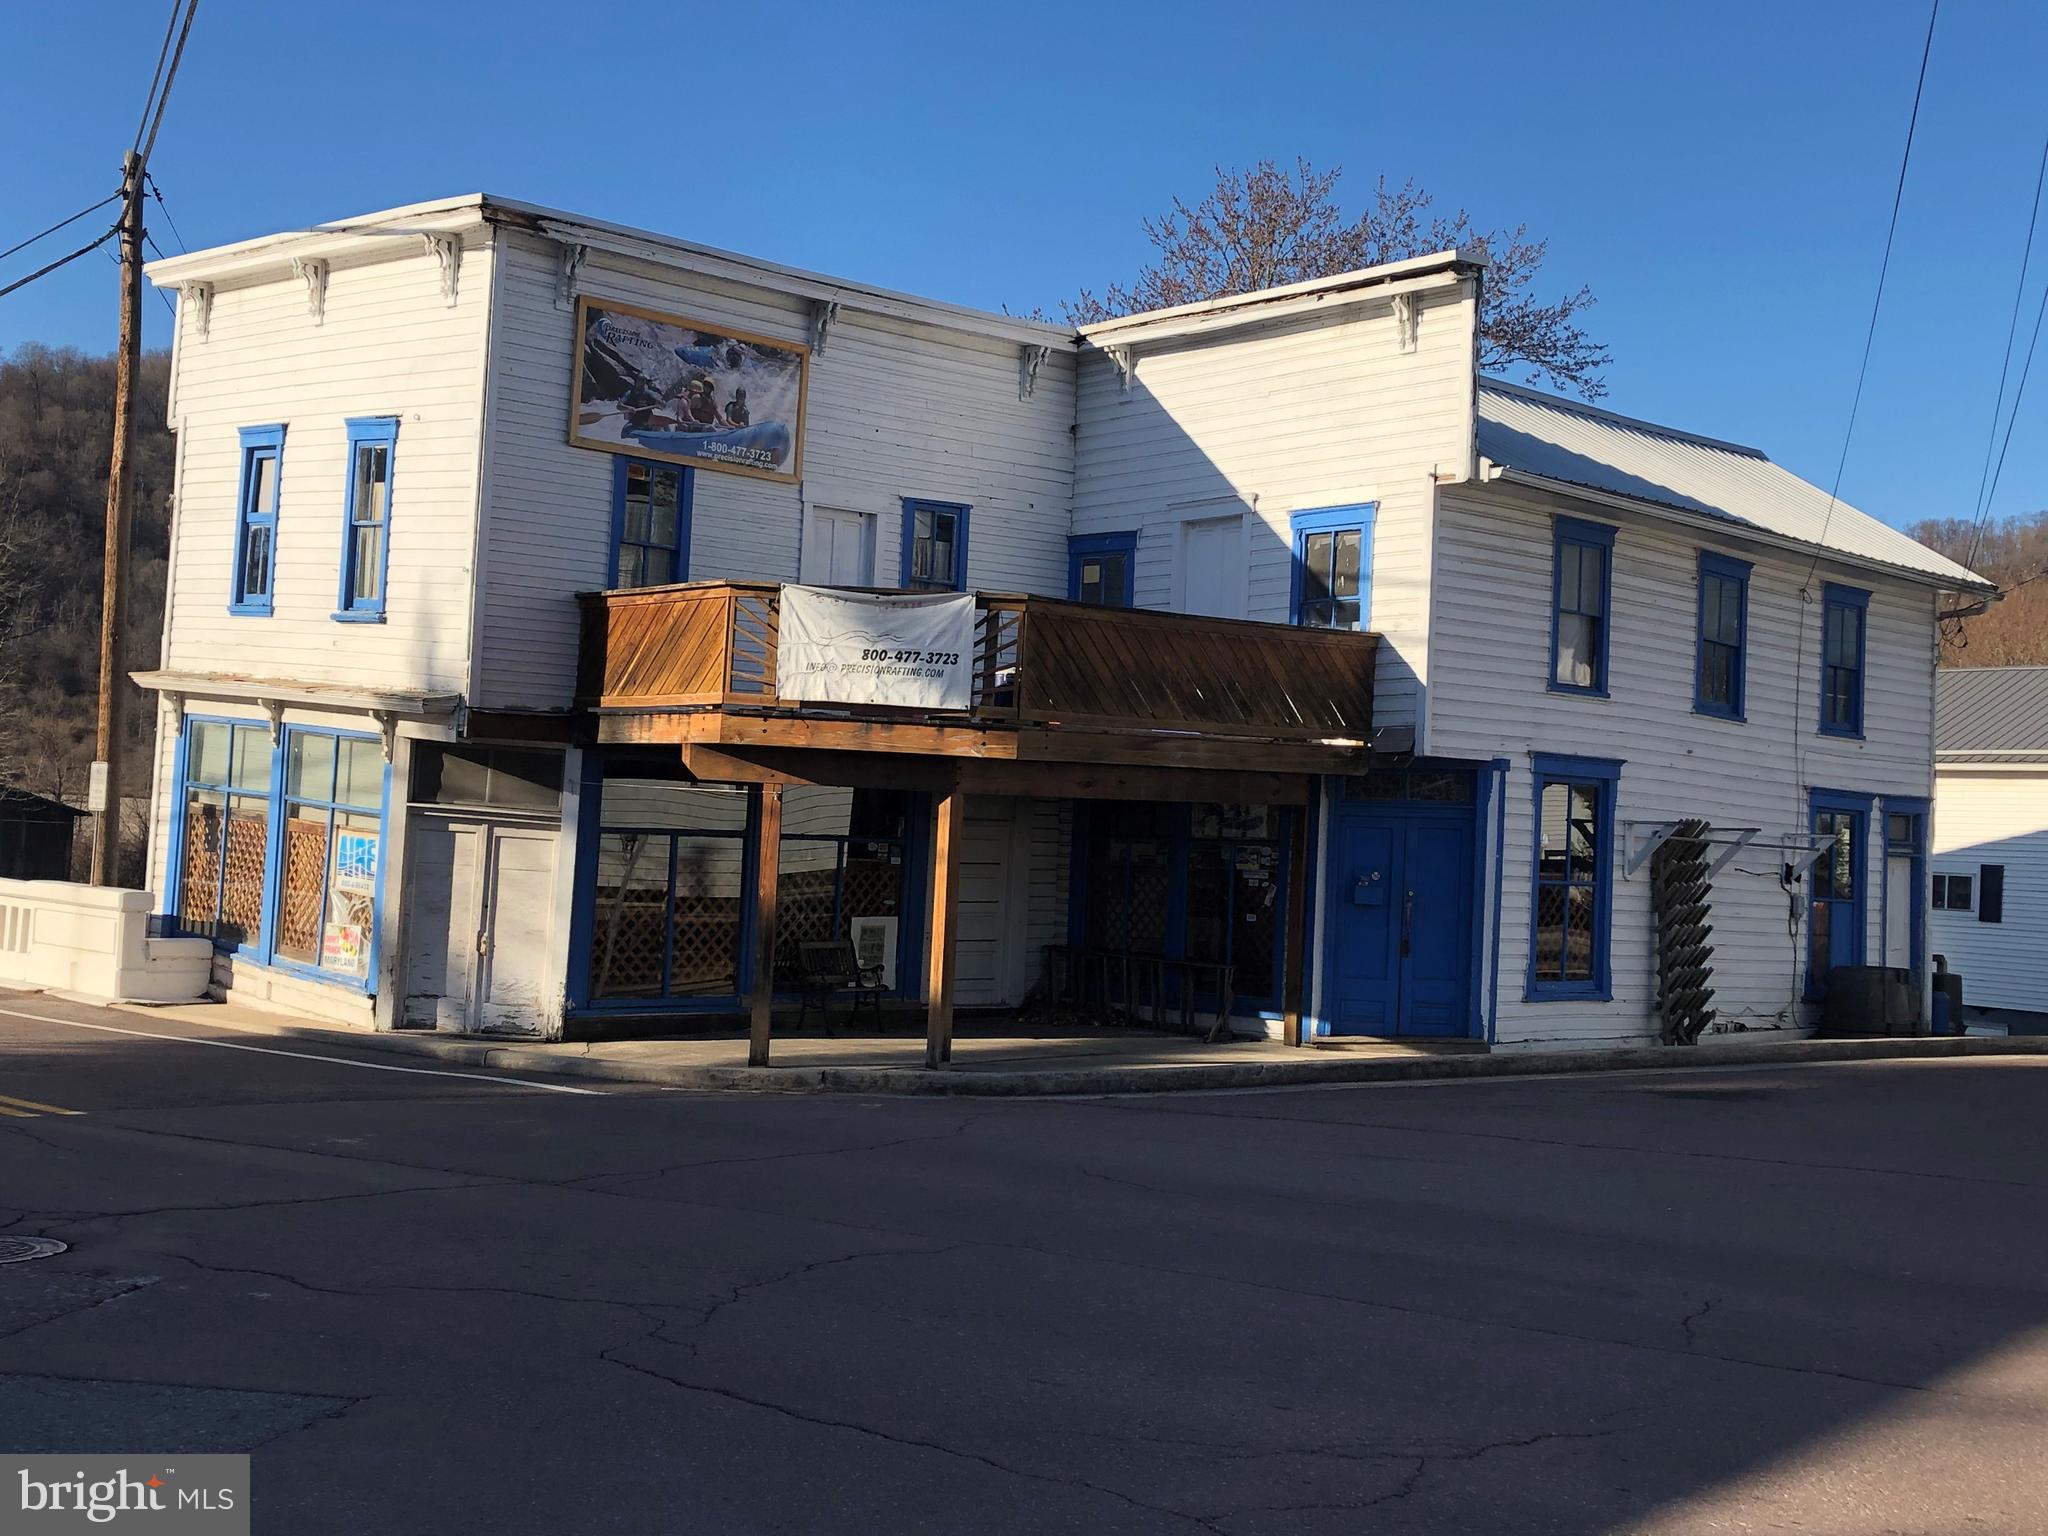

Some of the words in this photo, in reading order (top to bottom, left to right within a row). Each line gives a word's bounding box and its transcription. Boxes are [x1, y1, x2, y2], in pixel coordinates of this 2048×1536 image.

[606, 331, 654, 350] RAFTING
[702, 440, 772, 462] 1-800-477-3723
[861, 648, 960, 666] 800-477-3723
